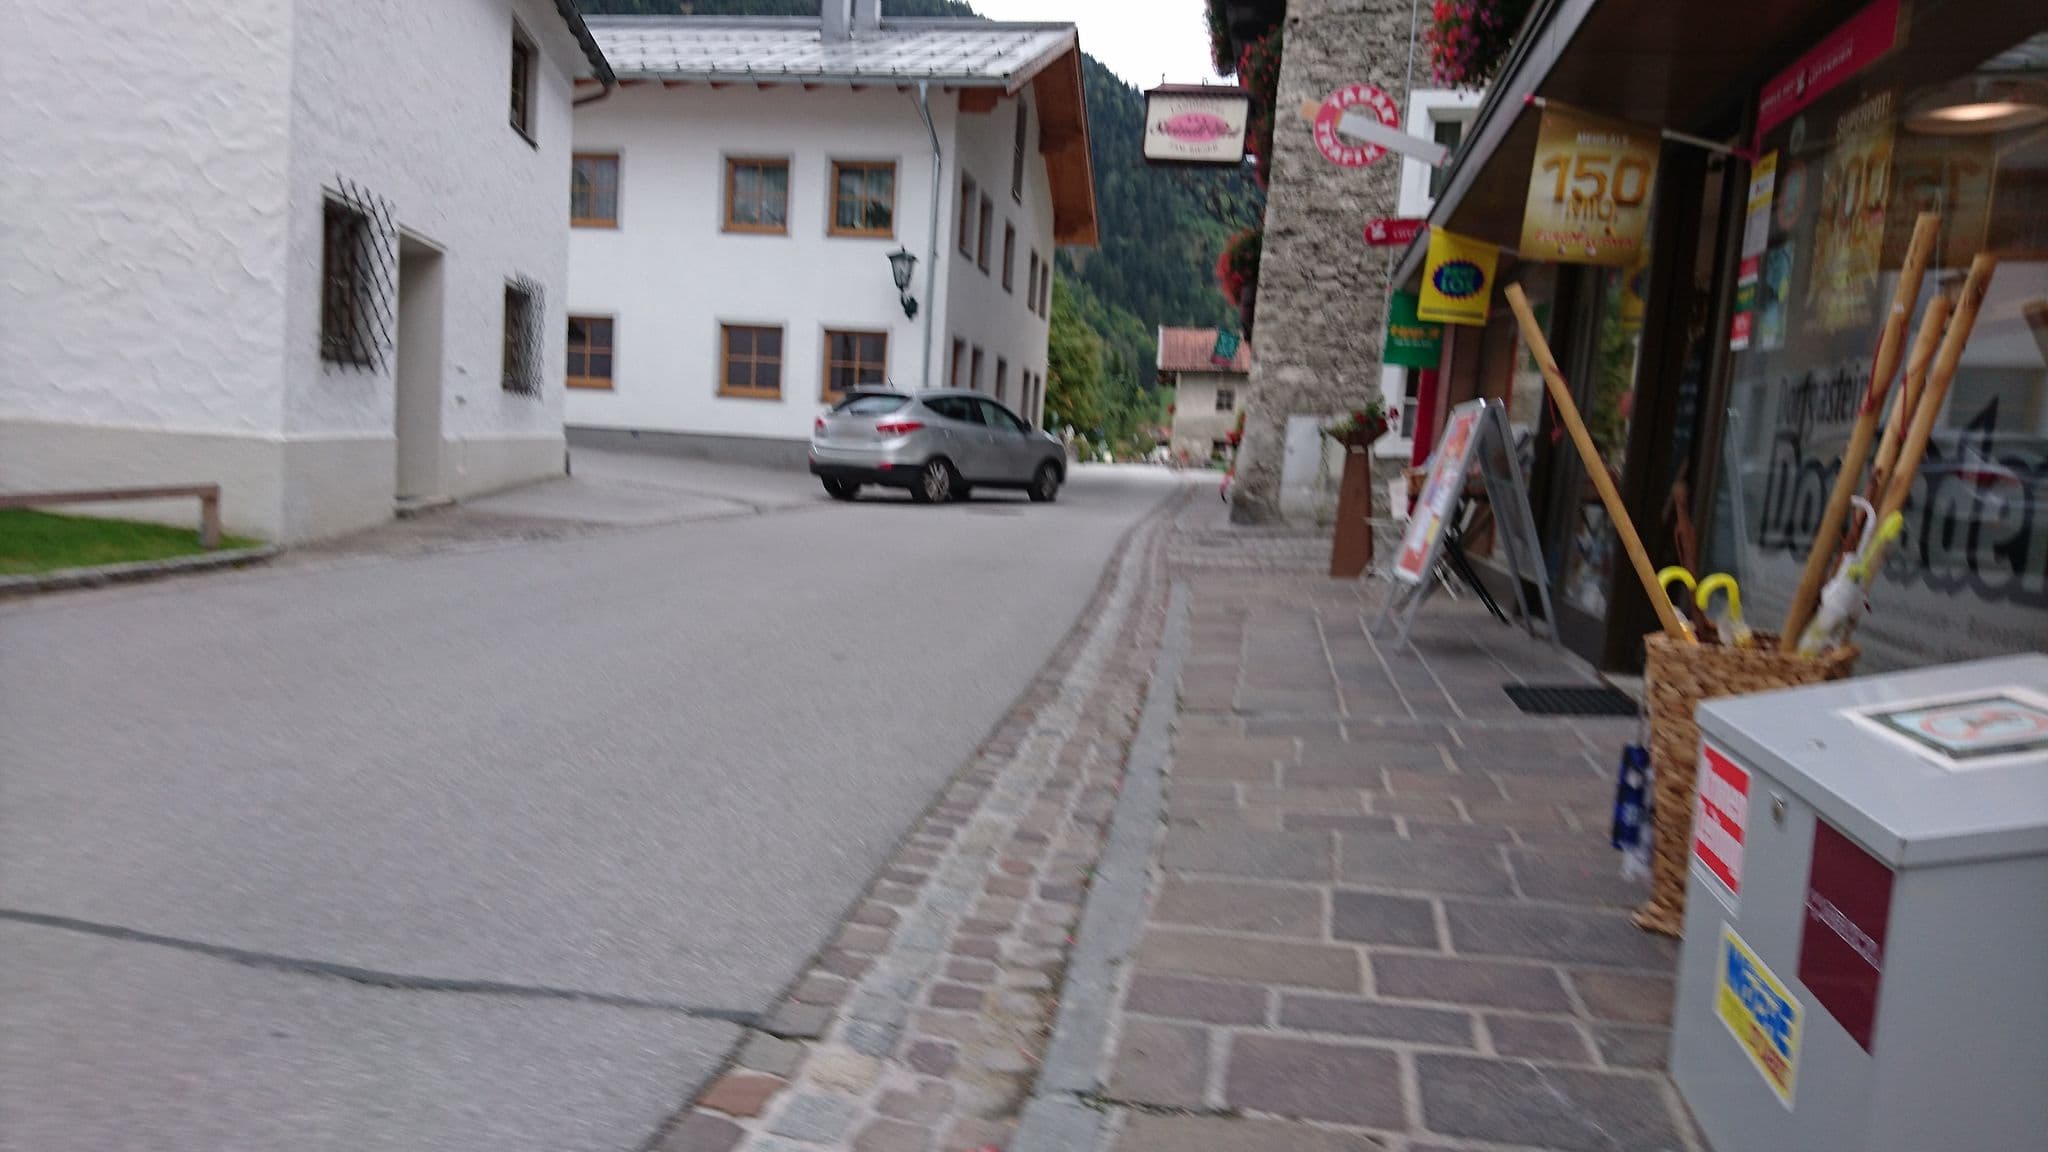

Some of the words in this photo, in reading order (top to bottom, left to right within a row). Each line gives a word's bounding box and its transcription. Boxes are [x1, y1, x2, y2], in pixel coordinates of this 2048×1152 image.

[1329, 87, 1396, 122] TABAK
[1317, 121, 1380, 164] TRAFIK
[1541, 152, 1652, 208] 150
